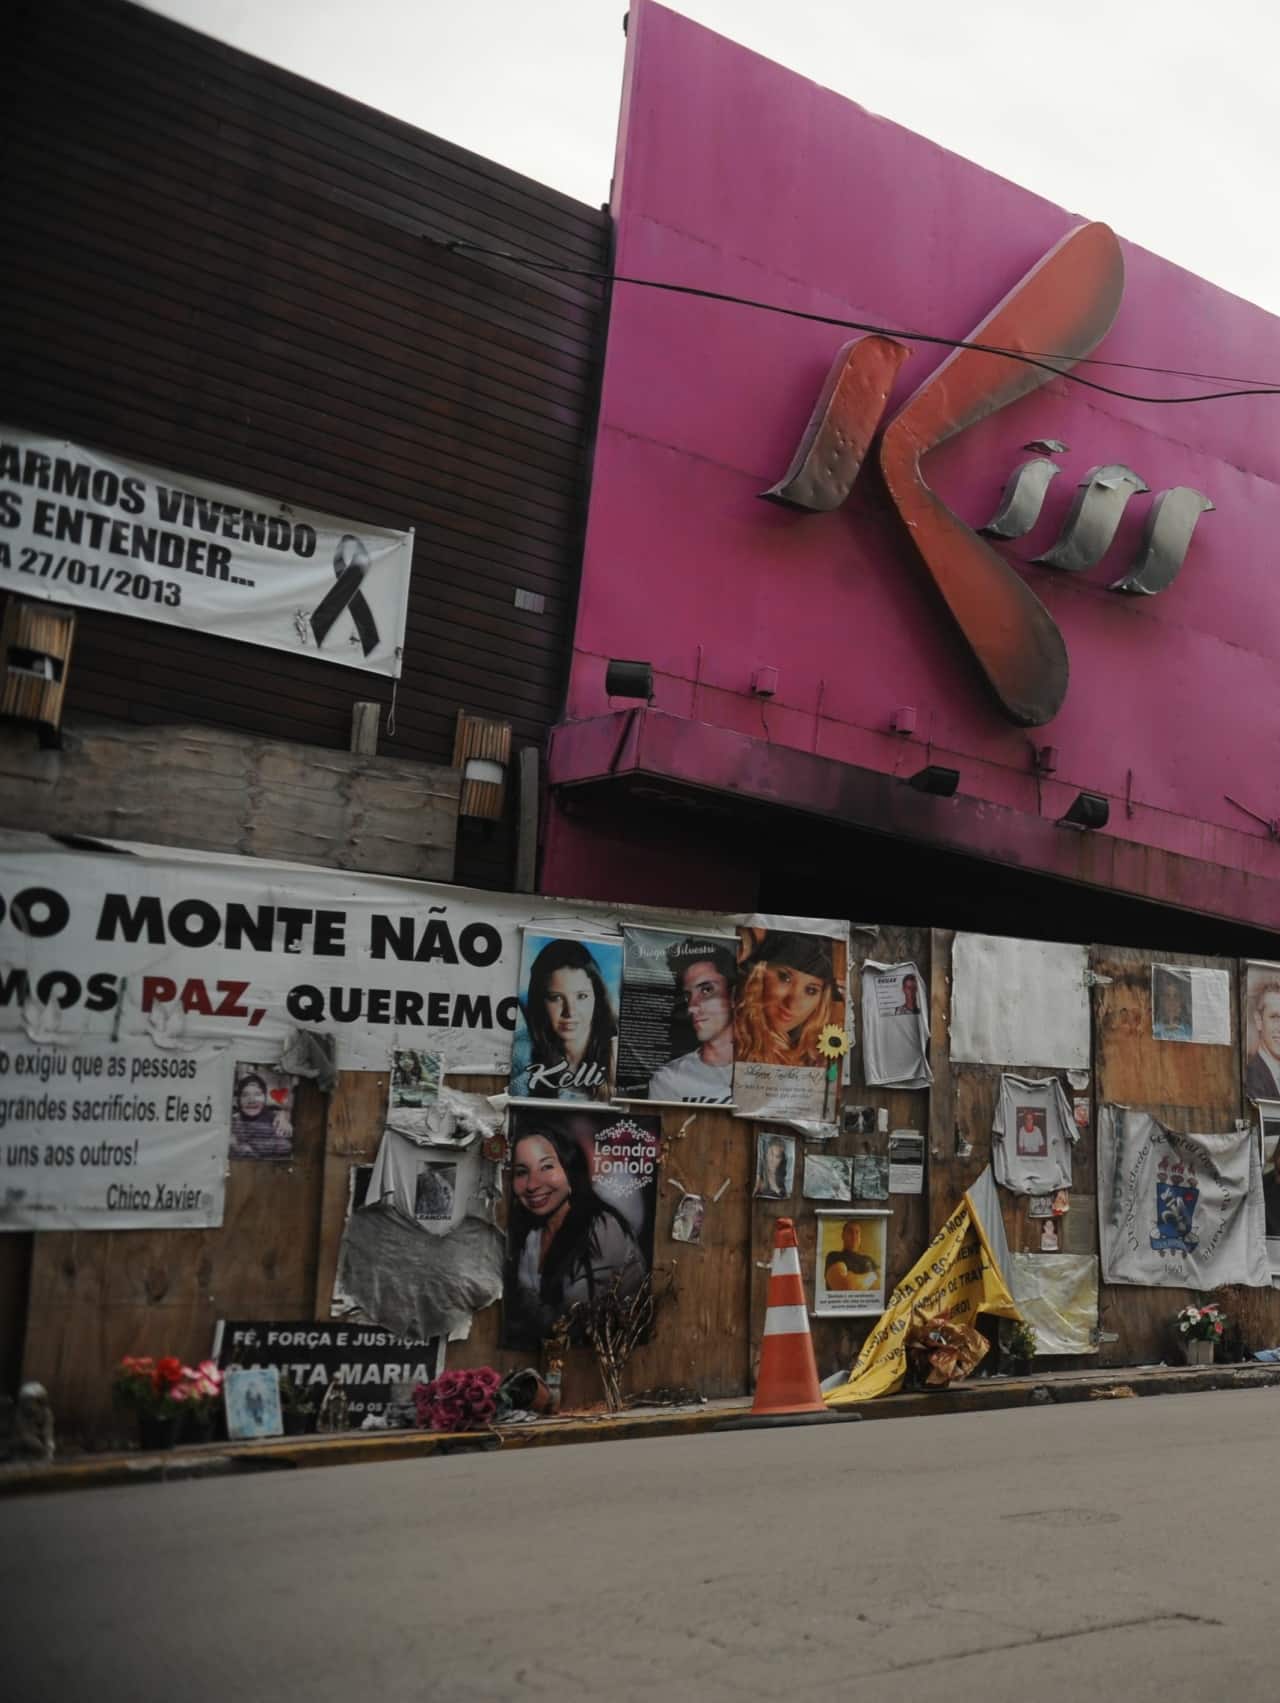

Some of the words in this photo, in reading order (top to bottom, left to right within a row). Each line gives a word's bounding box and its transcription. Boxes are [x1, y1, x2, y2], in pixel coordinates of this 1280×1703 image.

[156, 485, 317, 558] VIVENDO
[32, 499, 256, 588] ENTENDER...
[18, 546, 183, 607] 27/01/2013
[0, 886, 71, 938] O
[95, 893, 347, 957] MONTE
[370, 905, 504, 968] NÃO
[140, 975, 268, 1027] PAZ,
[15, 1048, 66, 1082] exigiu
[71, 1056, 103, 1082] que
[107, 1056, 126, 1077] as
[130, 1057, 197, 1083] pessoas
[526, 1060, 607, 1089] Kelli
[0, 1093, 67, 1129] grandes
[164, 1095, 189, 1122] Ele
[193, 1095, 212, 1123] só
[7, 1143, 39, 1166] uns
[43, 1143, 75, 1166] aos
[79, 1138, 139, 1166] outros!
[594, 1141, 657, 1157] Leandra
[592, 1157, 655, 1175] Toniolo
[106, 1183, 151, 1210] Chico
[155, 1183, 202, 1210] Xavier
[232, 1329, 262, 1347] FÉ,
[267, 1331, 331, 1350] FORÇA
[336, 1332, 349, 1346] E
[338, 1363, 430, 1386] MARIA
